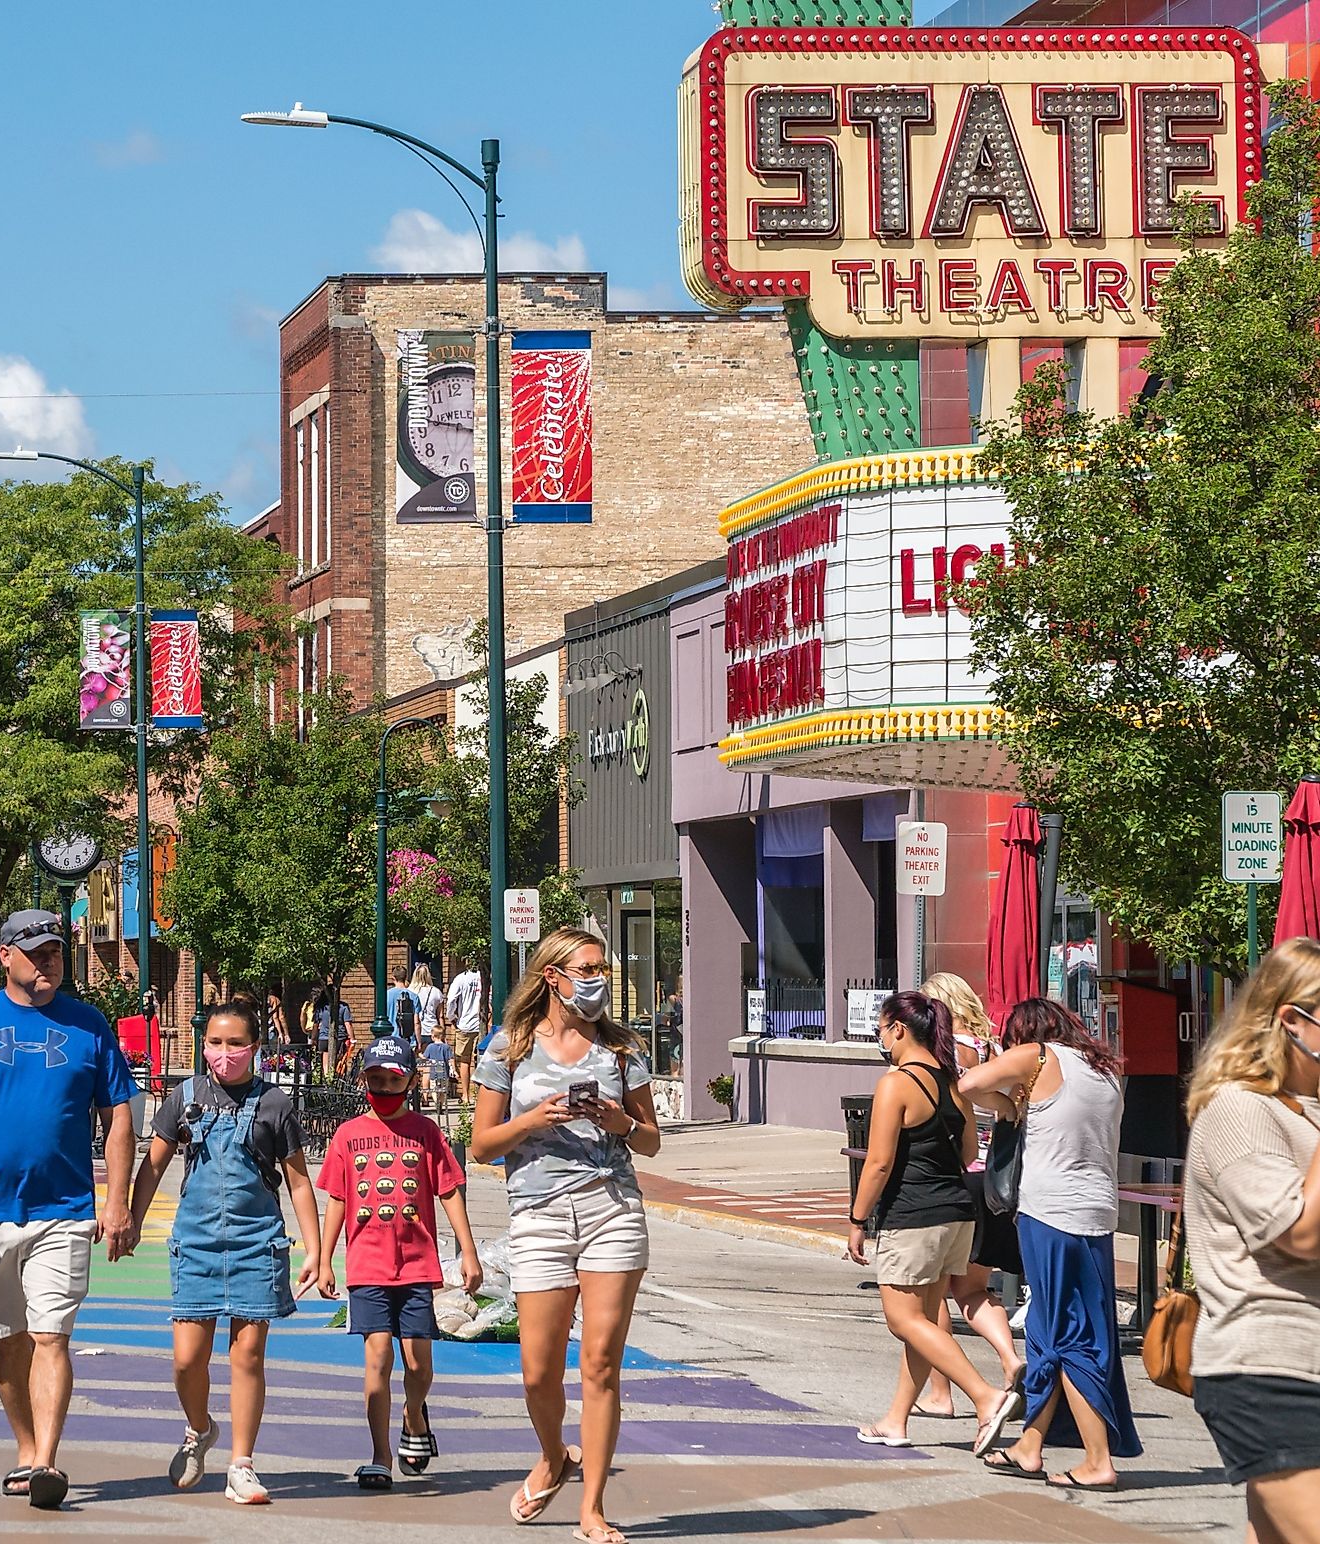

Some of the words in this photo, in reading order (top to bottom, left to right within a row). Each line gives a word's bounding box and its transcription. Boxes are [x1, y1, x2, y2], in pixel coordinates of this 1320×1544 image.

[746, 83, 1226, 239] STATE
[408, 343, 429, 428] DOWNTOWN
[447, 382, 462, 398] 12
[433, 409, 475, 427] JEWELE
[538, 353, 565, 501] Celebrate!
[791, 558, 828, 630] CITY
[86, 618, 101, 671] DOWNTOWN
[168, 623, 185, 715] Celebrate!
[1246, 804, 1258, 816] 15
[1231, 822, 1273, 834] MINUTE
[916, 832, 929, 843] NO
[82, 847, 89, 856] 4
[905, 846, 940, 857] PARKING
[1228, 839, 1278, 852] LOADING
[54, 854, 61, 864] 7
[63, 857, 70, 867] 6
[74, 853, 82, 864] 5
[1237, 857, 1268, 869] ZONE
[904, 860, 940, 872] THEATER
[912, 875, 930, 885] EXIT
[517, 896, 526, 904] NO
[509, 906, 535, 914] PARKING
[509, 916, 535, 924] THEATER
[515, 926, 529, 935] EXIT
[387, 1044, 403, 1055] with
[346, 1136, 380, 1153] MOODS
[392, 1135, 426, 1149] NINJA
